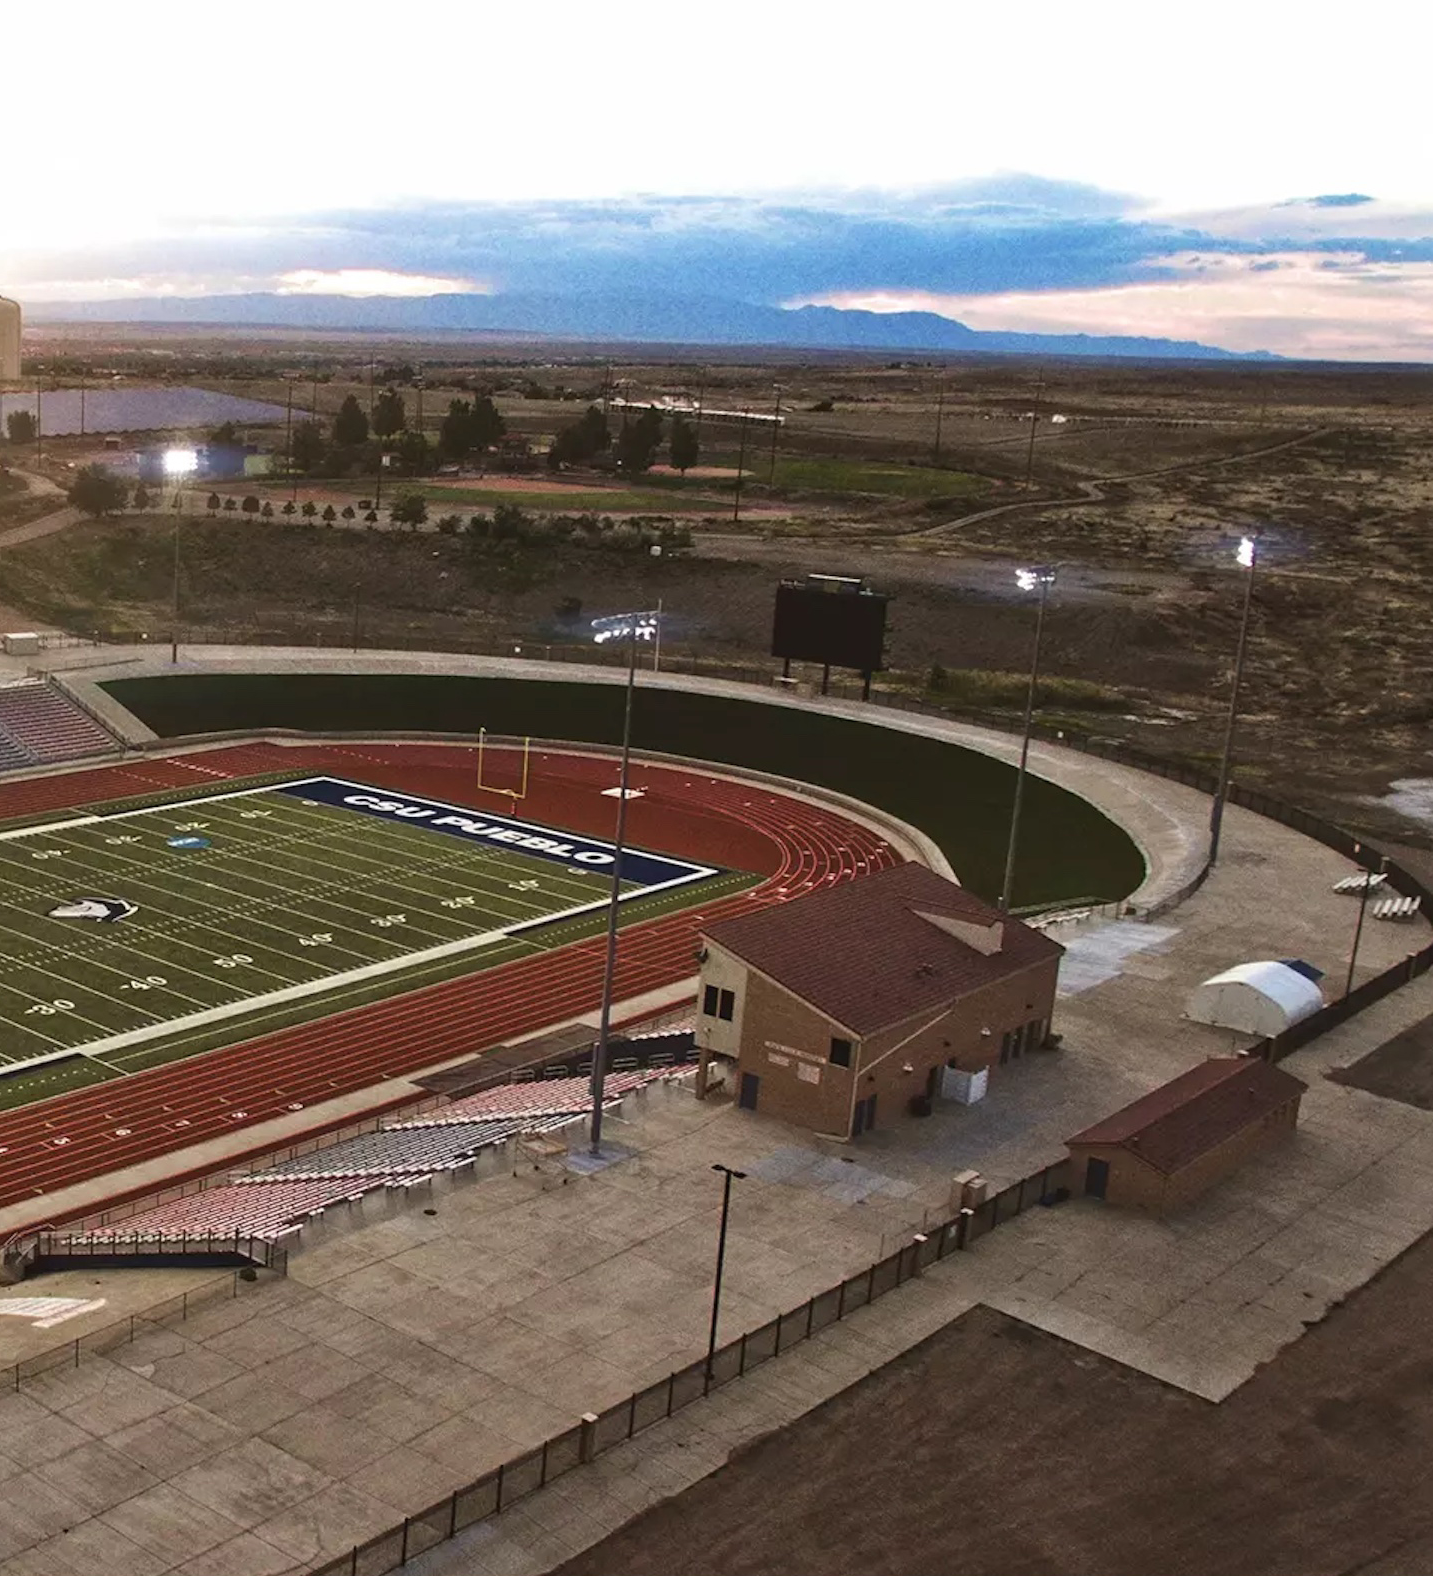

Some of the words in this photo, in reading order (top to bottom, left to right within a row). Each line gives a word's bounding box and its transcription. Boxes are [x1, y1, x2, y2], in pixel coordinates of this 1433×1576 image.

[344, 795, 437, 818] CSU
[430, 815, 615, 865] PUEBLO
[32, 999, 75, 1016] 30
[131, 976, 167, 990] 40
[213, 953, 253, 968] 50
